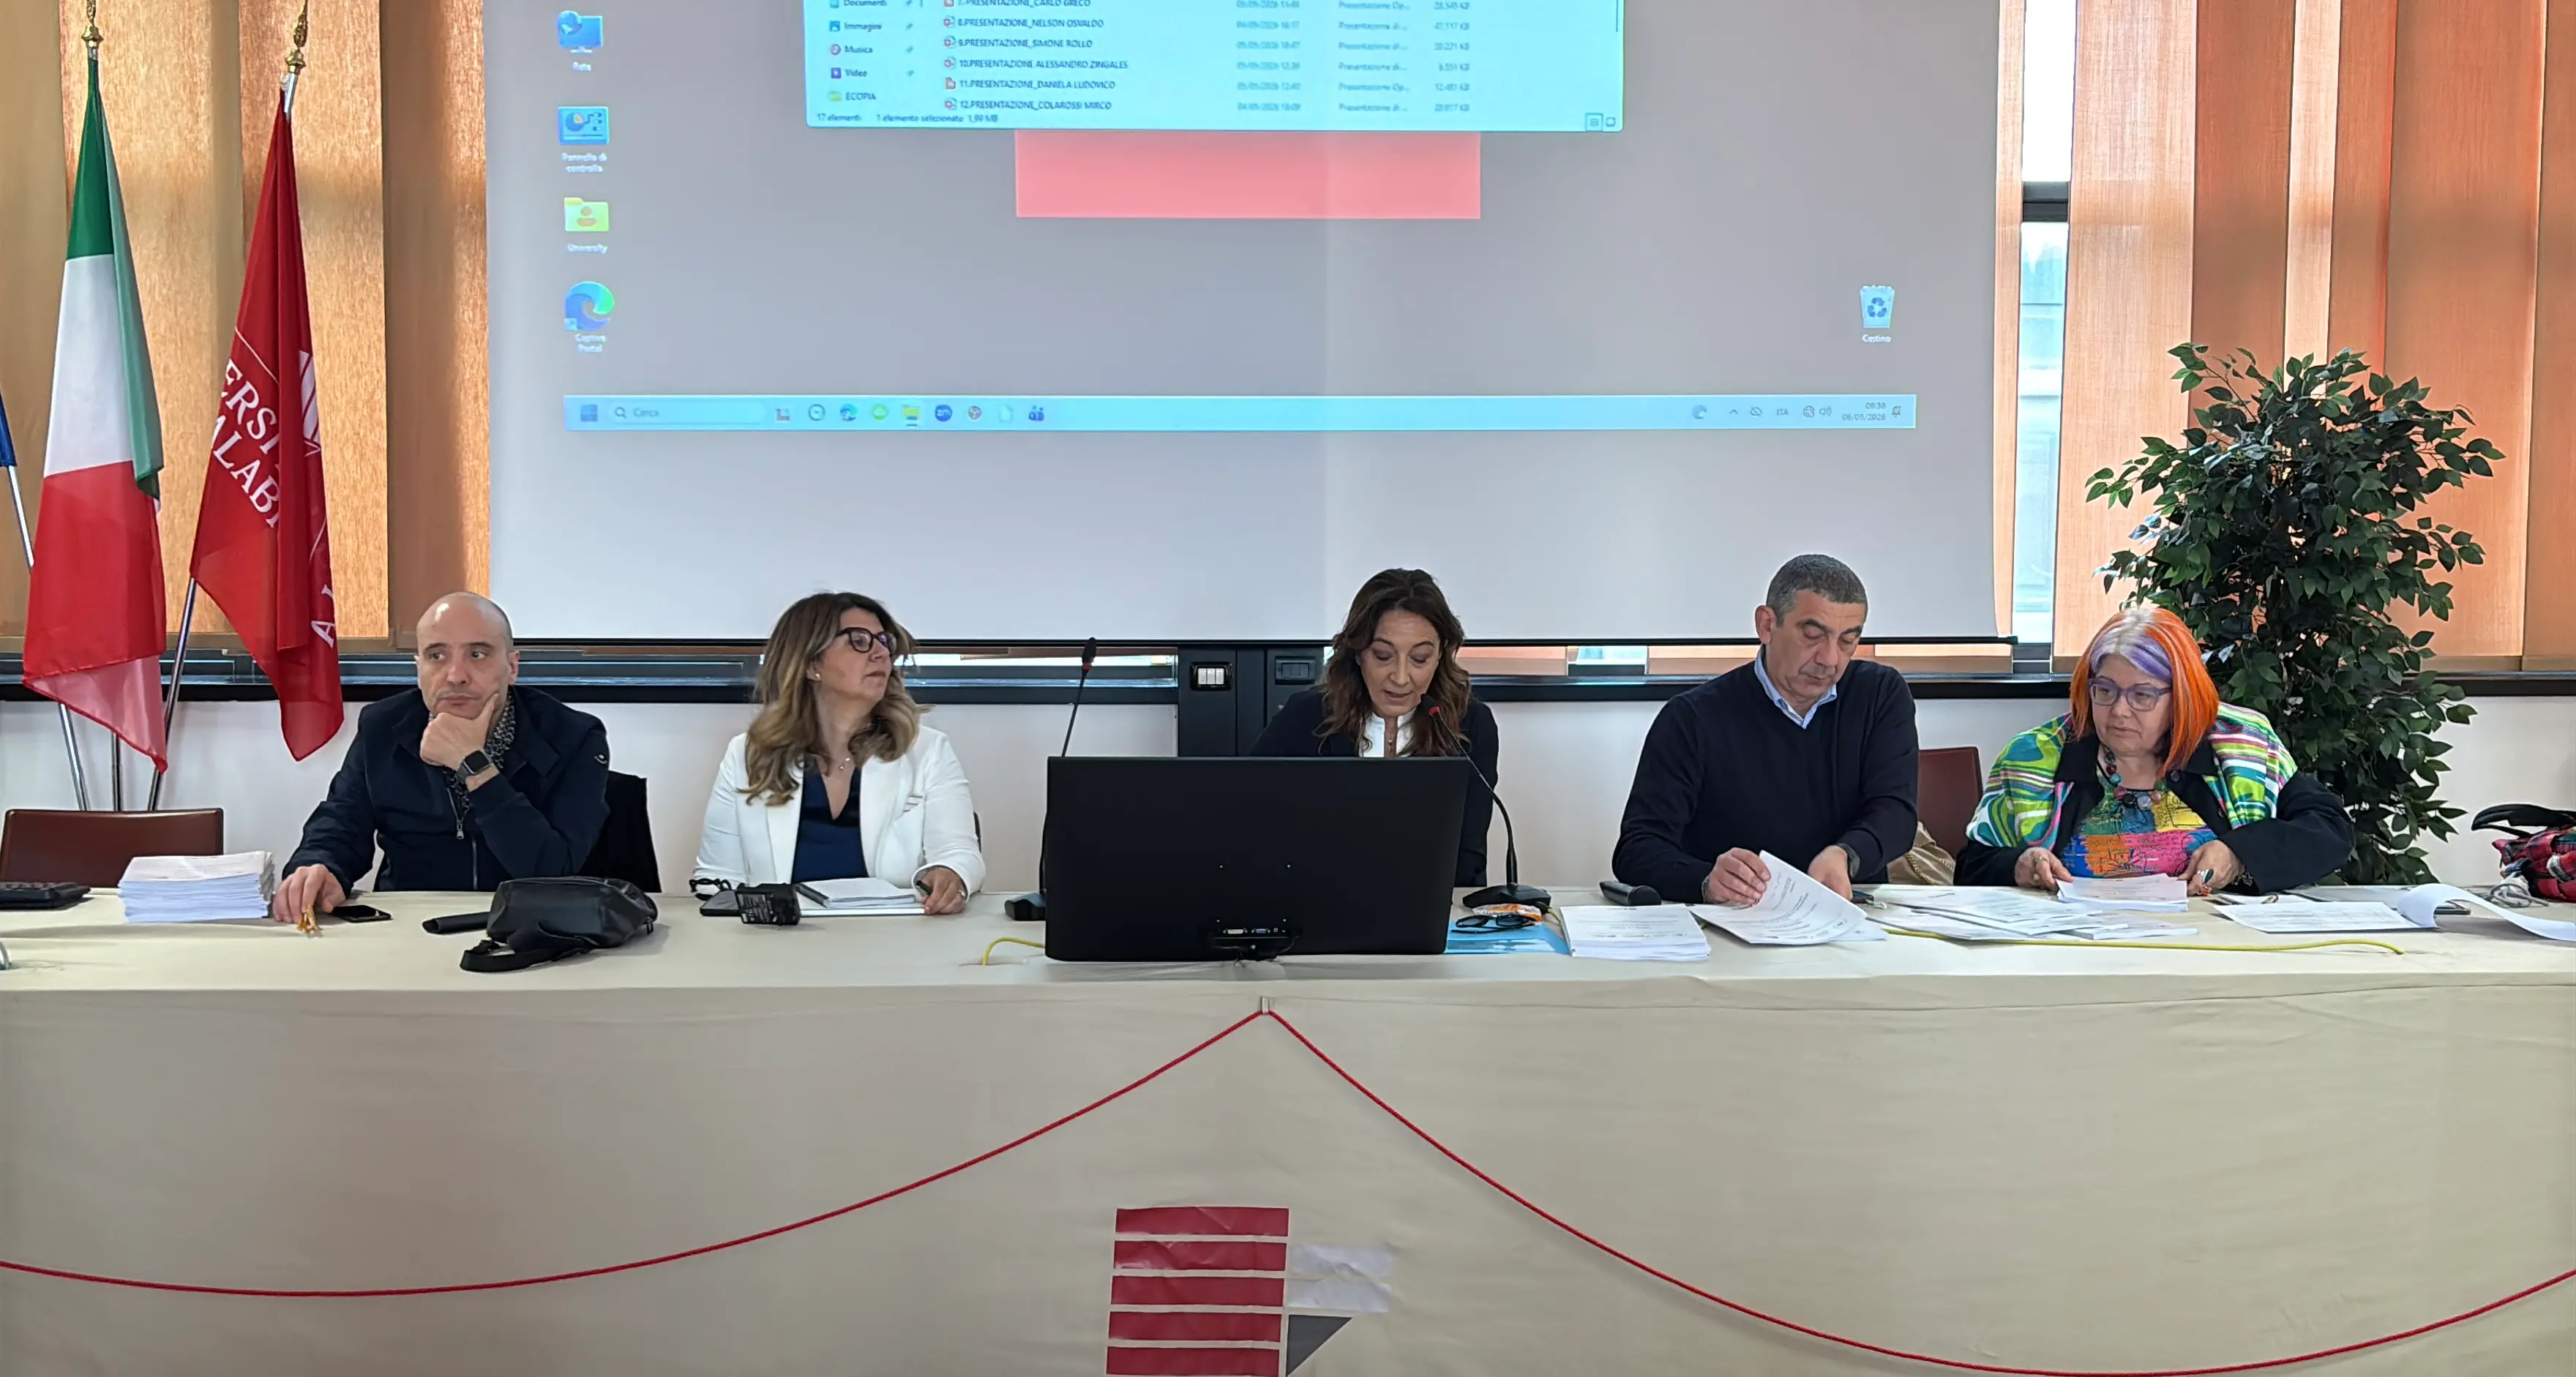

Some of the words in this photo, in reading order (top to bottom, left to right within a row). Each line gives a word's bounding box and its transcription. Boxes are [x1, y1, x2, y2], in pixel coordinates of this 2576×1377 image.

[844, 22, 882, 32] Immagini
[1067, 19, 1104, 28] OSVALDO
[1066, 40, 1093, 48] ROLLO
[845, 45, 873, 53] Musica
[1036, 60, 1088, 69] ALESSANDRO
[1090, 61, 1128, 70] ZINGALES
[845, 69, 867, 77] Video
[1074, 80, 1115, 89] LUDOVICO
[845, 92, 877, 101] ECOPIA
[1085, 101, 1112, 110] MIRCO
[828, 113, 862, 121] elementi
[883, 113, 919, 122] elemento
[921, 114, 964, 122] selezionato
[985, 114, 998, 123] MB
[565, 164, 603, 173] controllo
[566, 243, 608, 255] University
[1862, 334, 1891, 343] Cestino
[633, 407, 659, 418] Cerca
[1776, 408, 1789, 416] ITA
